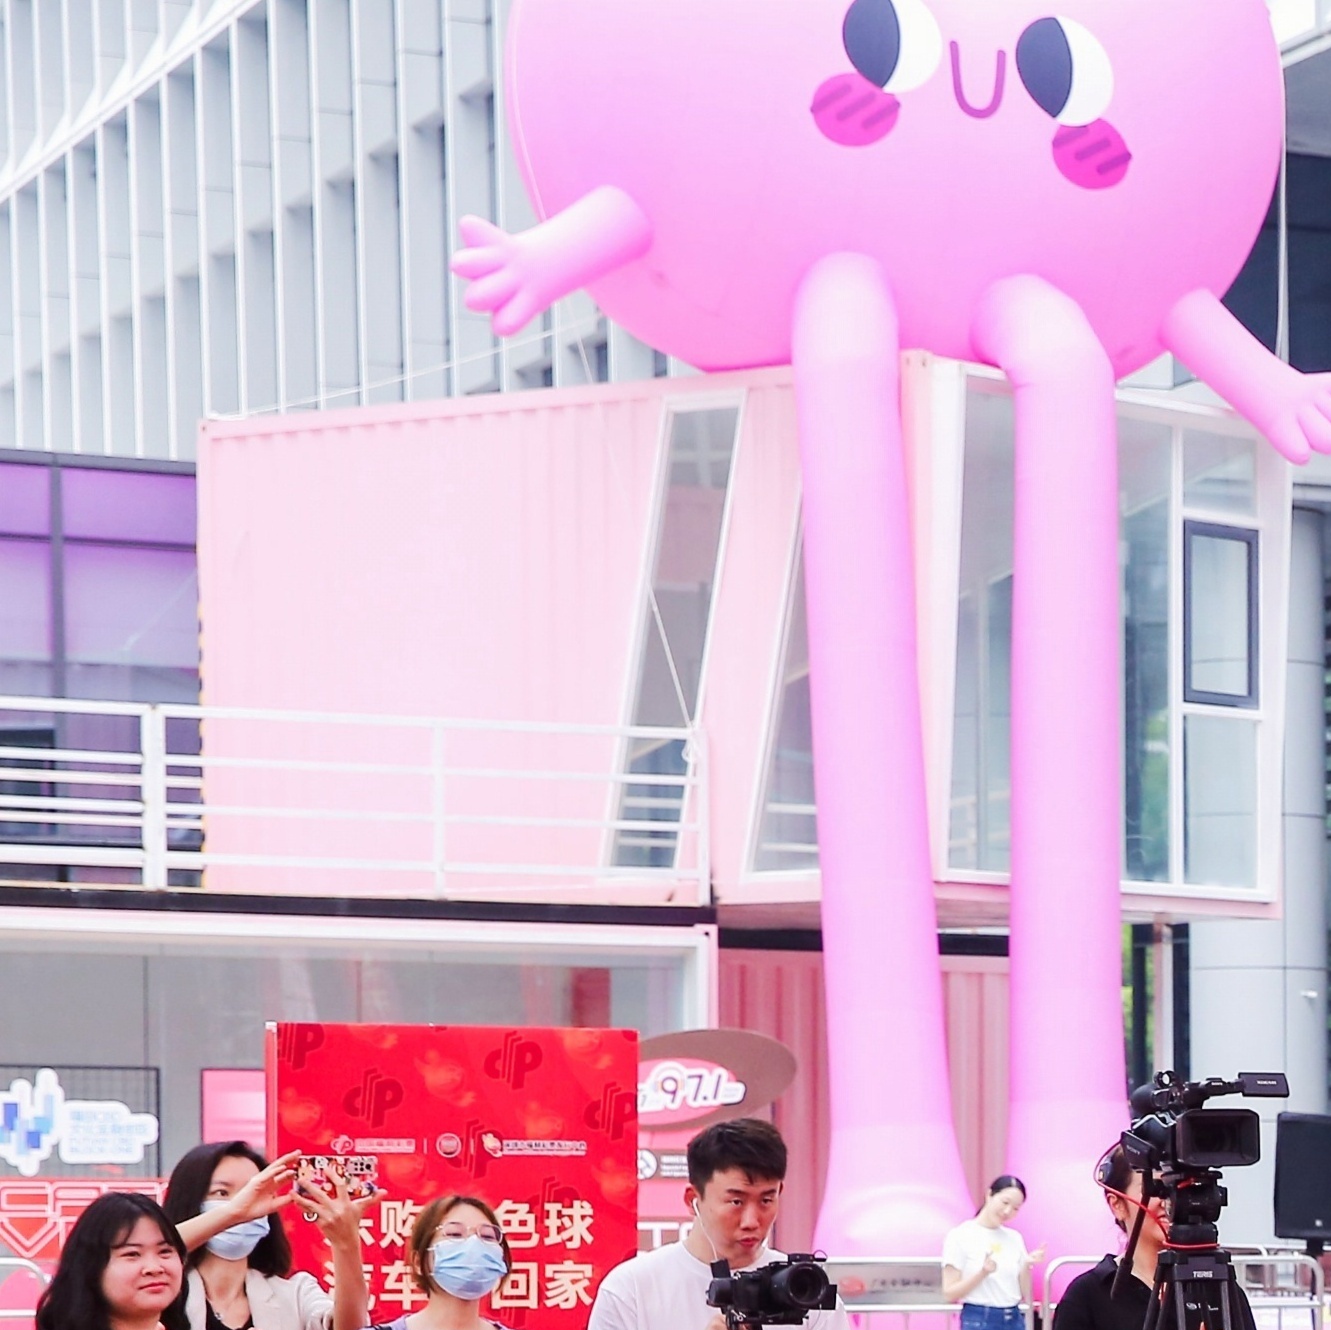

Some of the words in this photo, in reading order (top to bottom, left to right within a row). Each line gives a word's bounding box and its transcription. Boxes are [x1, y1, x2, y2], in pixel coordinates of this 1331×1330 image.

[661, 1074, 723, 1104] 97.1
[323, 1199, 594, 1249] 购色球
